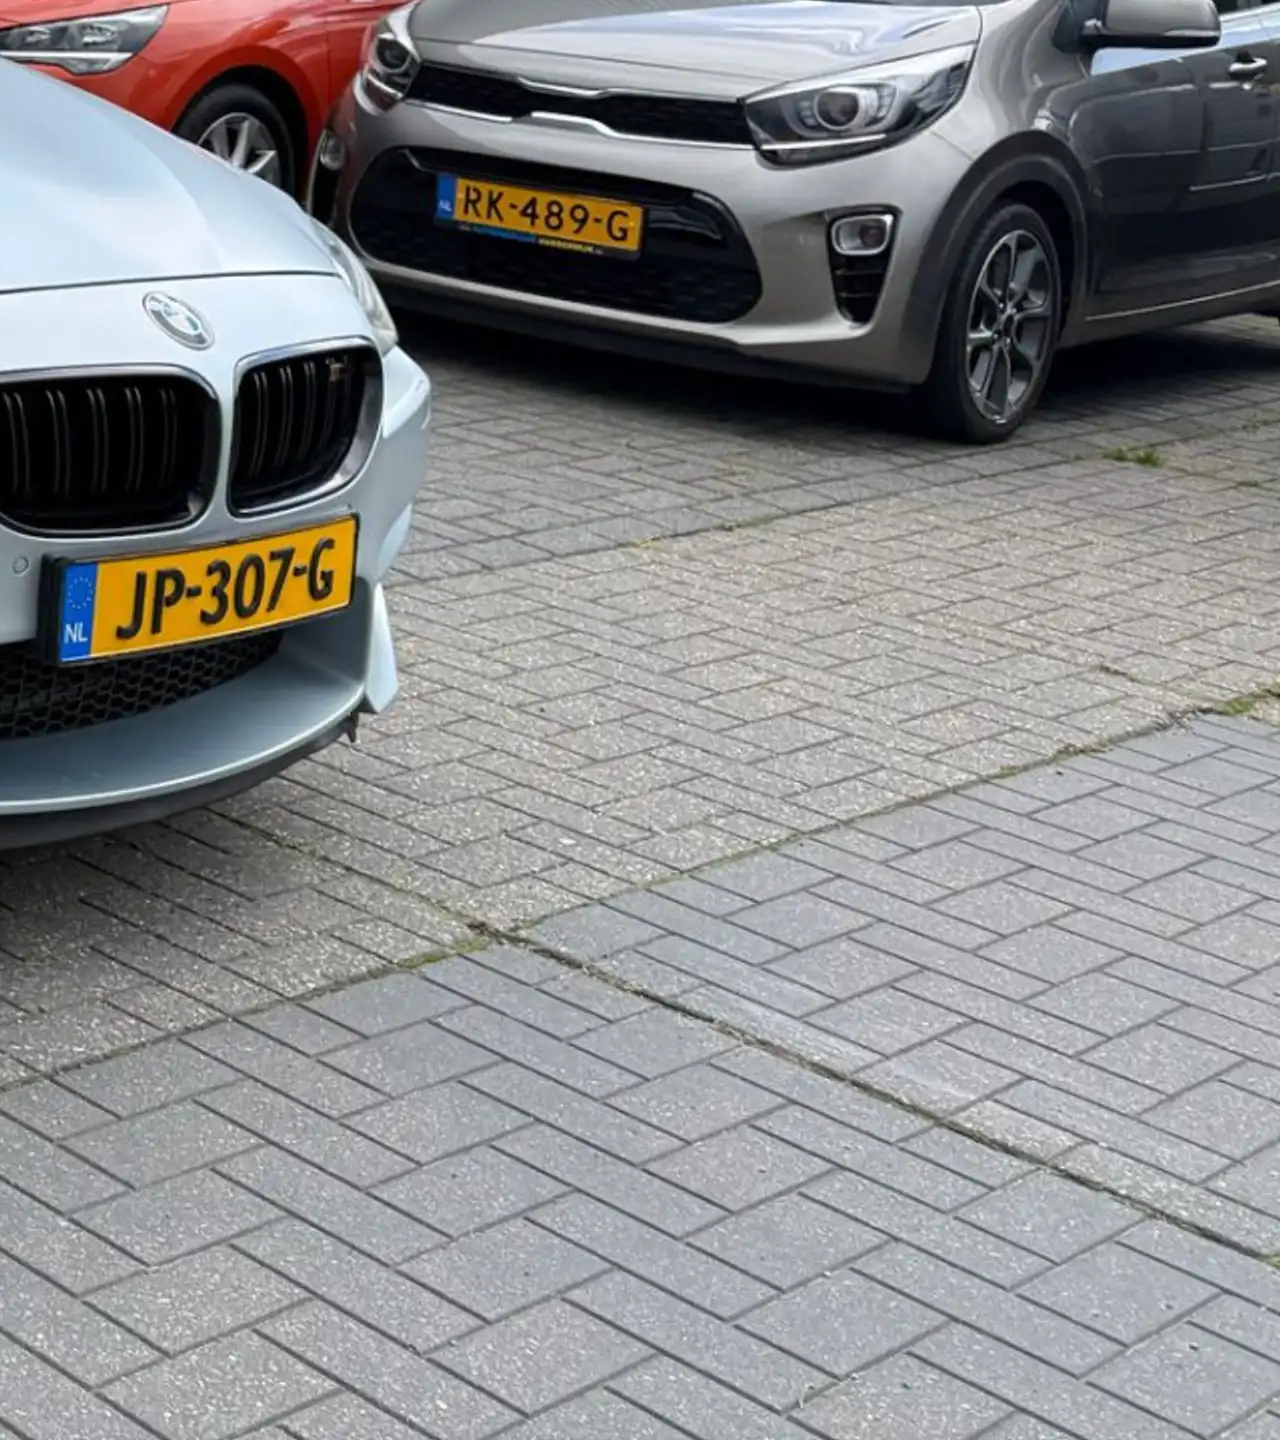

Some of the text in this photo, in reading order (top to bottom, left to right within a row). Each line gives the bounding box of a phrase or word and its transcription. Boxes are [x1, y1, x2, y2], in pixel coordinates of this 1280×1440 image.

[462, 185, 629, 243] RK-489-G
[115, 537, 336, 641] JP-307-G
[63, 622, 88, 645] NL
